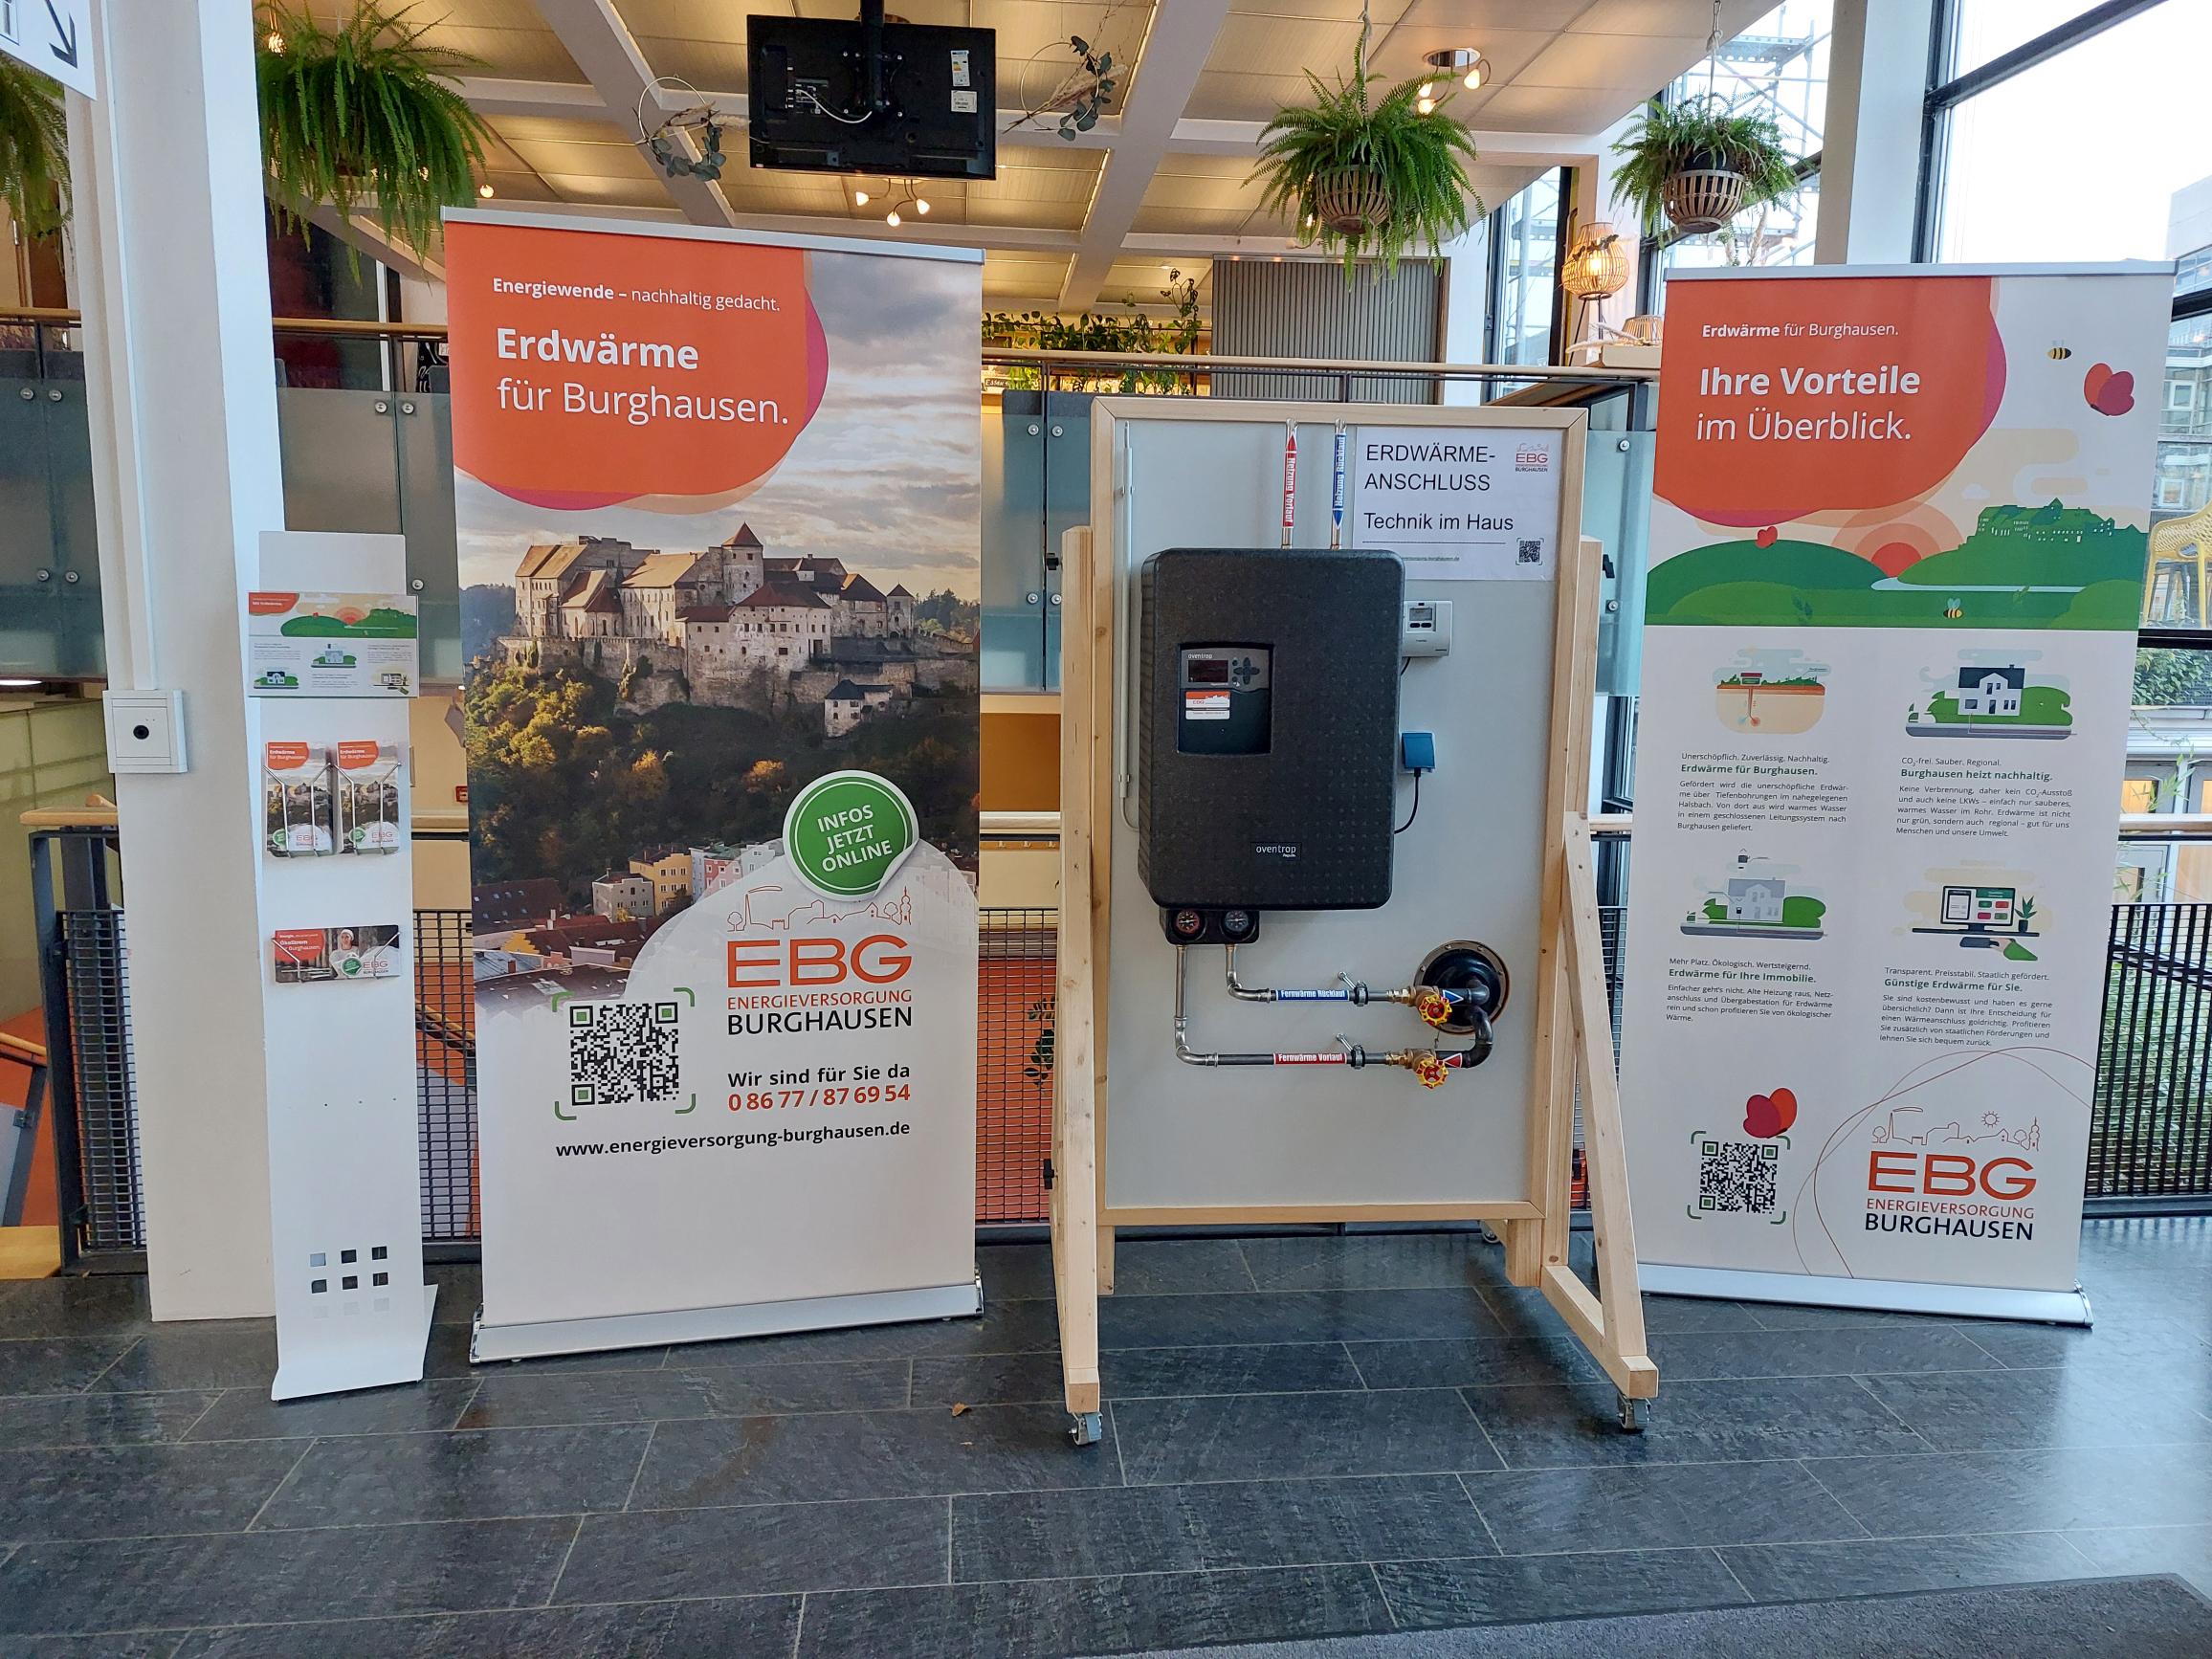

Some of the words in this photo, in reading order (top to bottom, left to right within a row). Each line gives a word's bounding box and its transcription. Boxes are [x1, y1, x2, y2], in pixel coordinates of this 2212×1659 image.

[493, 278, 614, 299] Energiewende
[631, 289, 712, 310] nachhaltig
[716, 292, 781, 312] gedacht.
[1702, 323, 1780, 338] Erdwärme
[1783, 322, 1805, 336] für
[1809, 321, 1898, 340] Burghausen.
[497, 328, 699, 369] Erdwärme
[1700, 367, 1770, 395] Ihre
[1781, 365, 1920, 395] Vorteile
[498, 378, 551, 411] für
[564, 383, 789, 426] Burghausen.
[1696, 413, 1736, 441] im
[1748, 408, 1912, 441] Überblick.
[1337, 437, 1345, 472] Rücklauf
[1366, 442, 1495, 462] ERDWÄRME-
[1516, 453, 1548, 463] EBG
[1286, 457, 1295, 491] Heizung
[1364, 473, 1490, 491] ANSCHLUSS
[1335, 475, 1344, 506] Heizung
[1285, 494, 1294, 522] Vorlauf
[1364, 513, 1432, 529] Technik
[1440, 514, 1460, 529] im
[1468, 515, 1514, 530] Haus
[1682, 753, 1739, 762] Unerschöpflich.
[1741, 754, 1785, 763] Zuverlässig.
[1788, 755, 1829, 764] Nachhaltig.
[1967, 759, 2002, 767] Regional.
[1682, 764, 1732, 773] Erdwärme
[1754, 766, 1818, 776] Burghausen.
[1901, 769, 1962, 780] Burghausen
[1966, 770, 1991, 779] heizt
[1995, 771, 2052, 782] nachhaltig.
[1758, 783, 1814, 791] unerschöpfliche
[1716, 792, 1777, 801] Tiefenbohrungen
[1793, 794, 1847, 803] nahegelegenen
[817, 804, 874, 832] INFOS
[1677, 823, 1719, 831] Burghausen
[1769, 813, 1825, 823] Leitungssystem
[825, 825, 874, 854] JETZT
[821, 839, 893, 874] ONLINE
[1256, 845, 1296, 853] oventrop
[727, 934, 912, 987] EBG
[1670, 969, 1719, 978] Erdwärme
[1763, 973, 1817, 982] Immobilie.
[1885, 979, 1929, 989] Günstige
[1933, 981, 1984, 990] Erdwärme
[727, 989, 912, 1010] ENERGIEVERSORGUNG
[1281, 989, 1316, 998] Fernwärme
[1317, 989, 1345, 998] Rücklauf
[1721, 997, 1779, 1006] Übergabestation
[1763, 988, 1792, 997] Heizung
[1916, 996, 1970, 1005] kostenbewusst
[728, 1007, 912, 1035] BURGHAUSEN
[1905, 1015, 1965, 1025] Wärmeanschluss
[1989, 1009, 2037, 1019] Entscheidung
[1935, 1037, 1964, 1046] bequem
[1987, 1029, 2032, 1039] Förderungen
[728, 1072, 763, 1088] Wir
[769, 1069, 809, 1085] sind
[817, 1067, 846, 1083] für
[853, 1065, 880, 1082] Sie
[887, 1063, 910, 1079] da
[556, 1121, 910, 1158] www.energieversorgung-burghausen.de
[1868, 1150, 2037, 1201] EBG
[1867, 1198, 2035, 1219] ENERGIEVERSORGUNG
[1865, 1213, 2034, 1241] BURGHAUSEN
